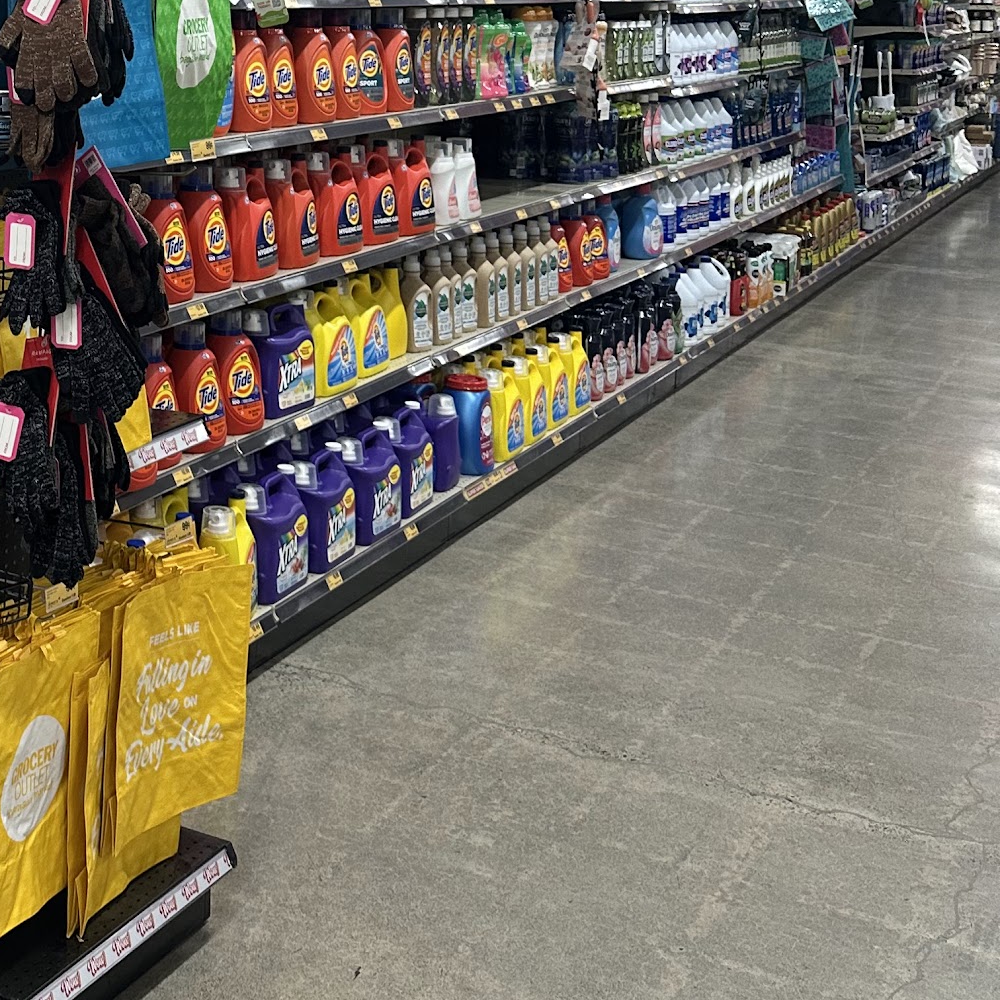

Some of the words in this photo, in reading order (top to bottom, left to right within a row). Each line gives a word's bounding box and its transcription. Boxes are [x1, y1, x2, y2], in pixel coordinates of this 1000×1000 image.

[363, 56, 377, 70] Tide
[249, 69, 265, 90] Tide
[276, 67, 292, 85] Tide
[316, 67, 330, 85] Tide
[166, 238, 185, 257] Tide
[208, 226, 225, 247] Tide
[232, 369, 252, 393] Tide
[279, 358, 302, 393] XTRA
[199, 386, 217, 409] Tide
[373, 482, 392, 519] XTRA
[278, 535, 297, 577] XTRA
[150, 630, 175, 646] FEELS
[177, 621, 199, 636] LIKE
[136, 657, 188, 703] Falling
[191, 649, 213, 677] in
[140, 695, 179, 735] Love
[12, 740, 59, 785] GROCERY
[125, 738, 164, 783] Every
[15, 764, 49, 800] OUTLET
